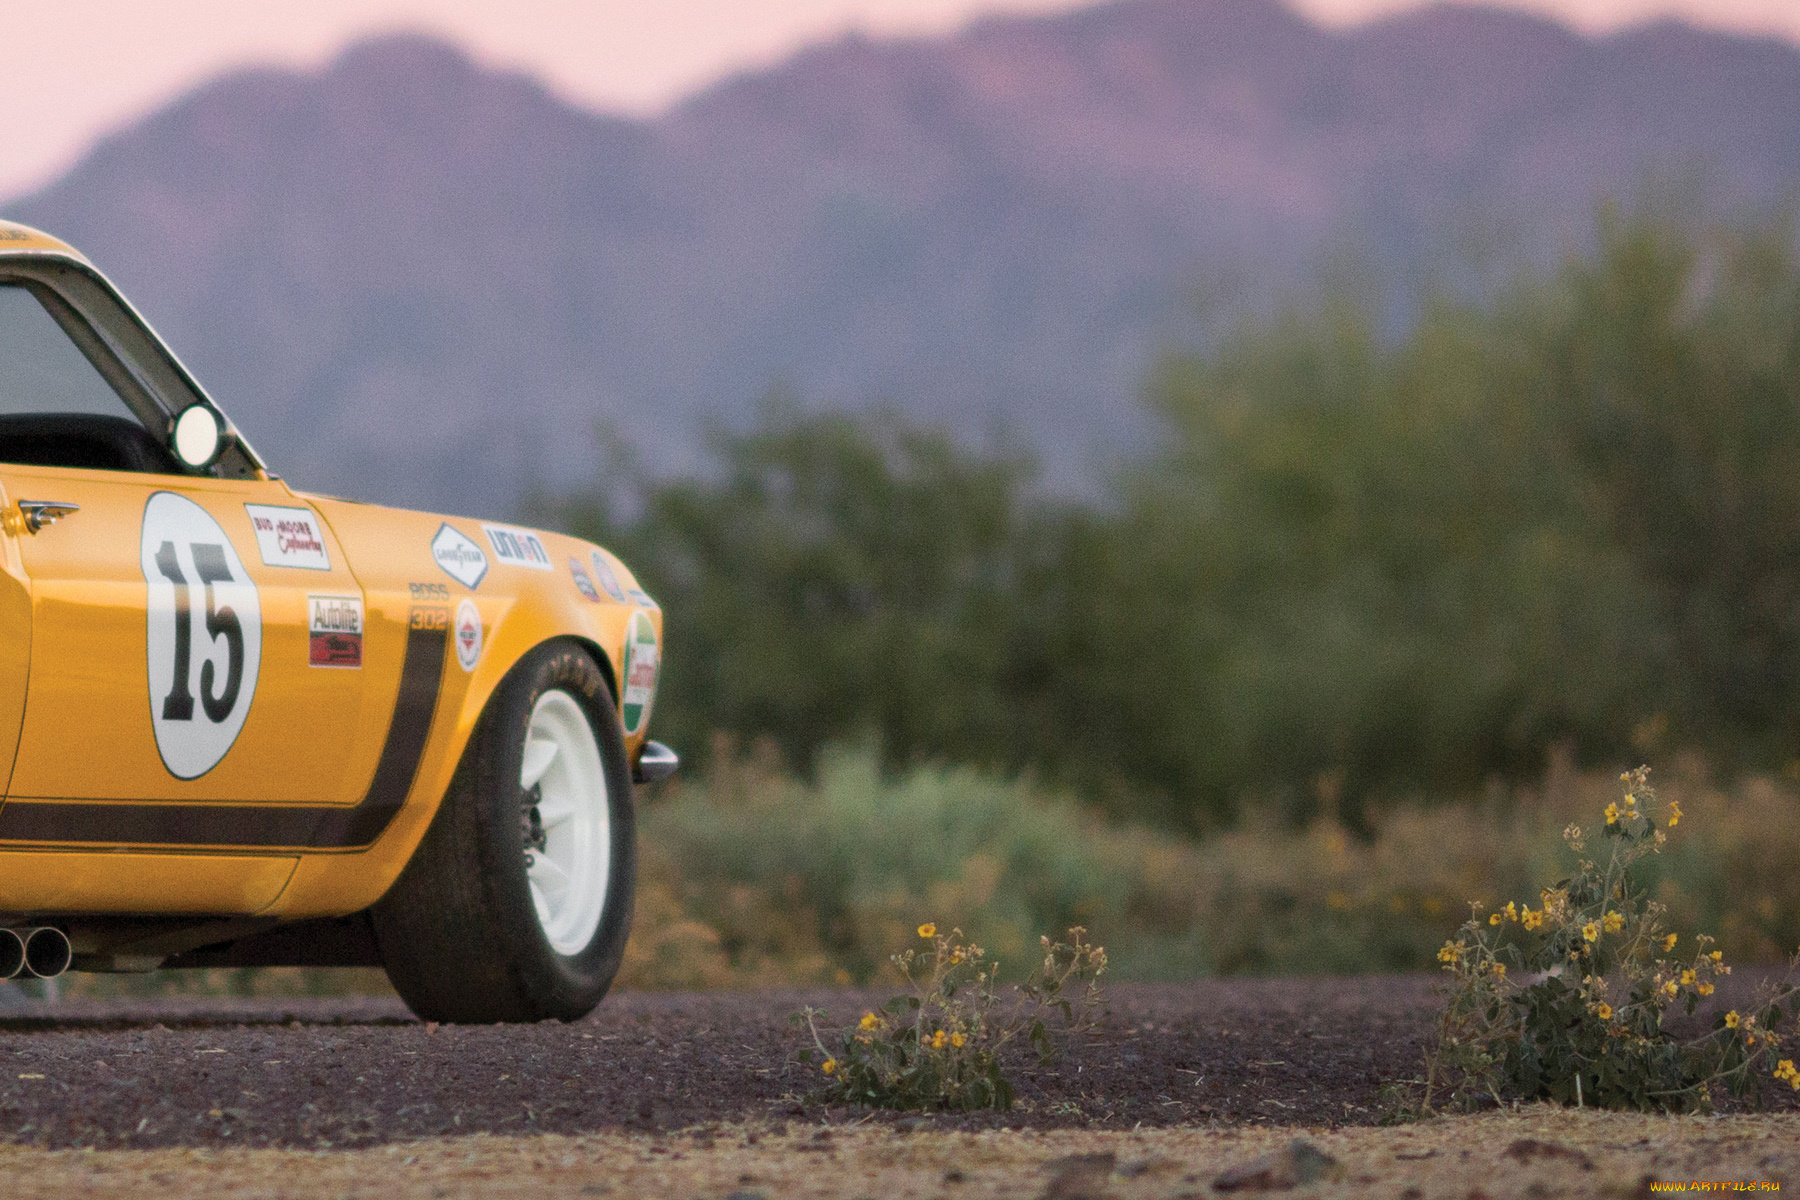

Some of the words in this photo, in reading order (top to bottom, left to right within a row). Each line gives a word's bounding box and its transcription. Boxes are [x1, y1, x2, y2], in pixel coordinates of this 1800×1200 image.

[253, 517, 274, 531] BUD
[411, 610, 446, 630] 302
[155, 541, 244, 723] 15
